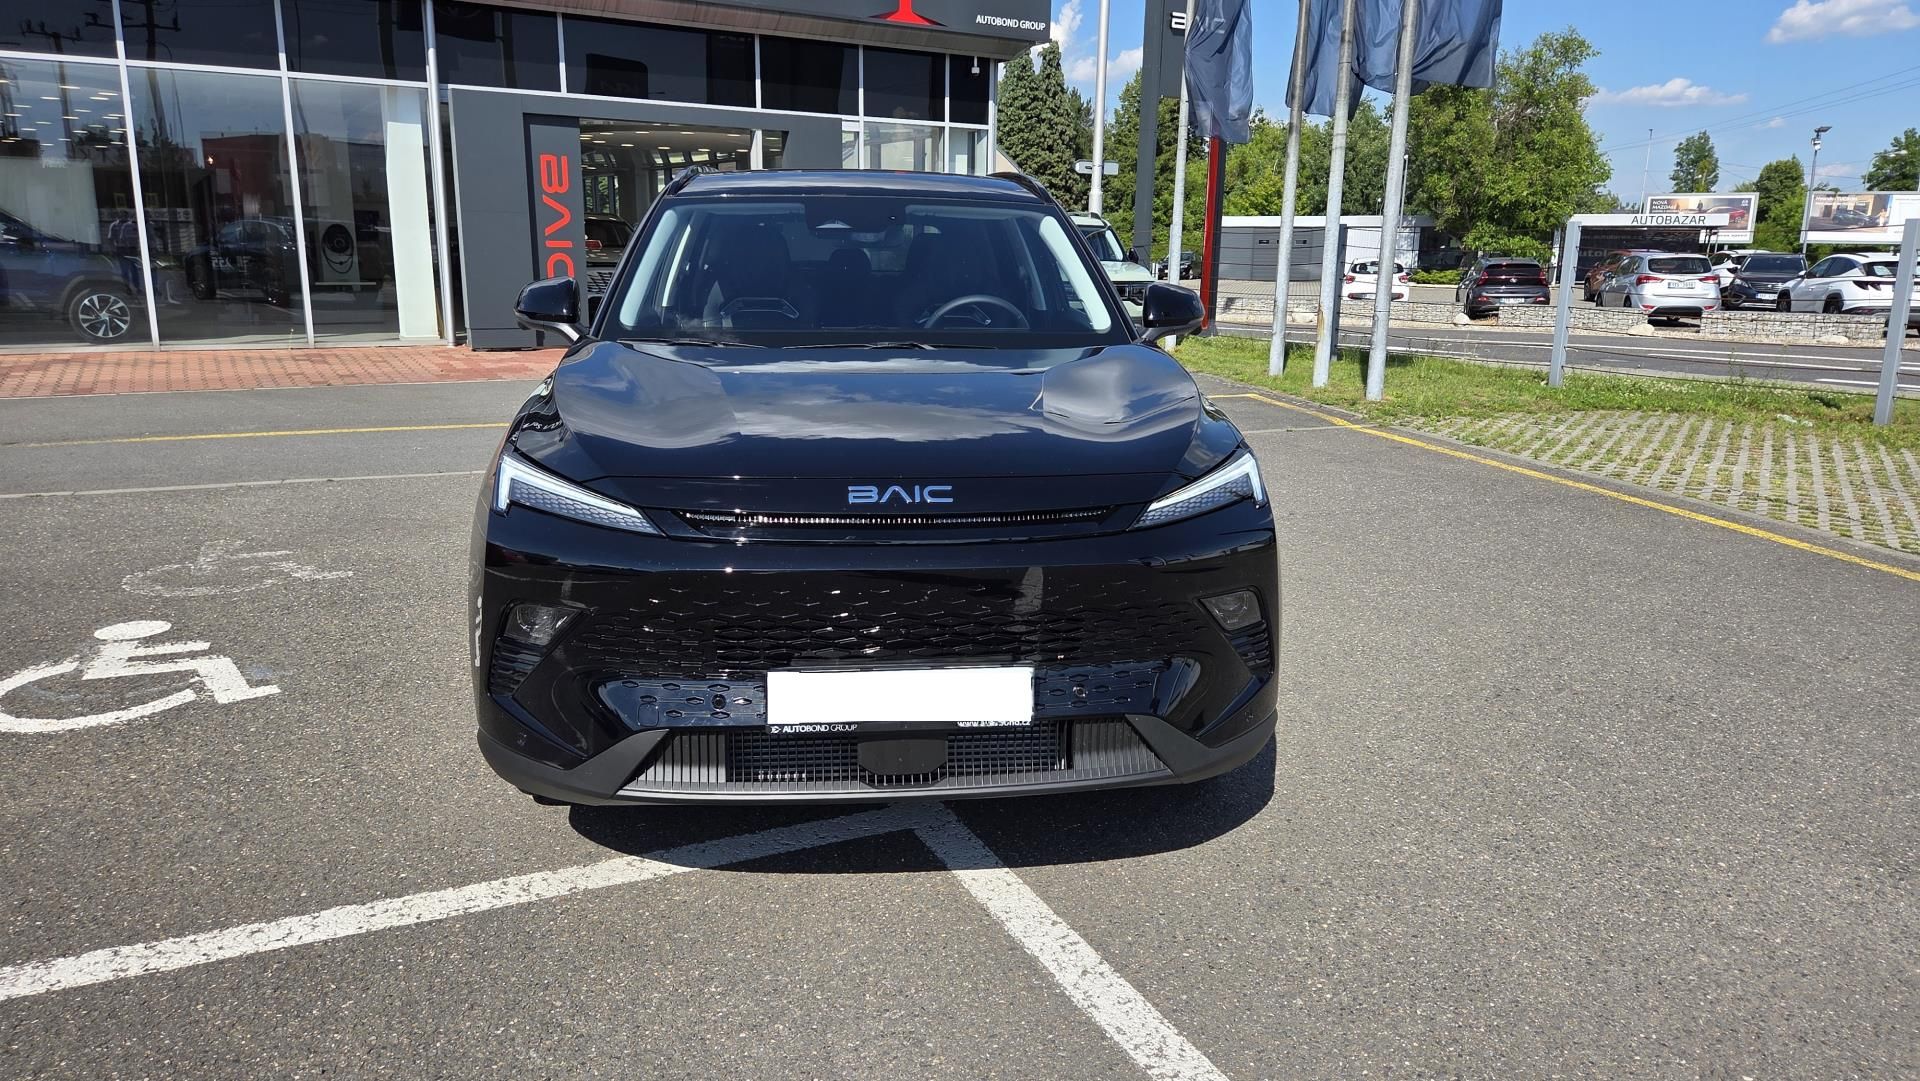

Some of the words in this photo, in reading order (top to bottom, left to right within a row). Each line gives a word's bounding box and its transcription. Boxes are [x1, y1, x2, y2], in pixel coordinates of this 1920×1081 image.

[976, 14, 1018, 28] AUTOBOND
[1020, 20, 1046, 31] GROUP
[1631, 215, 1706, 225] AUTOBAZAR
[848, 485, 954, 503] BAIC
[782, 724, 829, 733] AUTOBOND
[830, 723, 857, 732] GROUP
